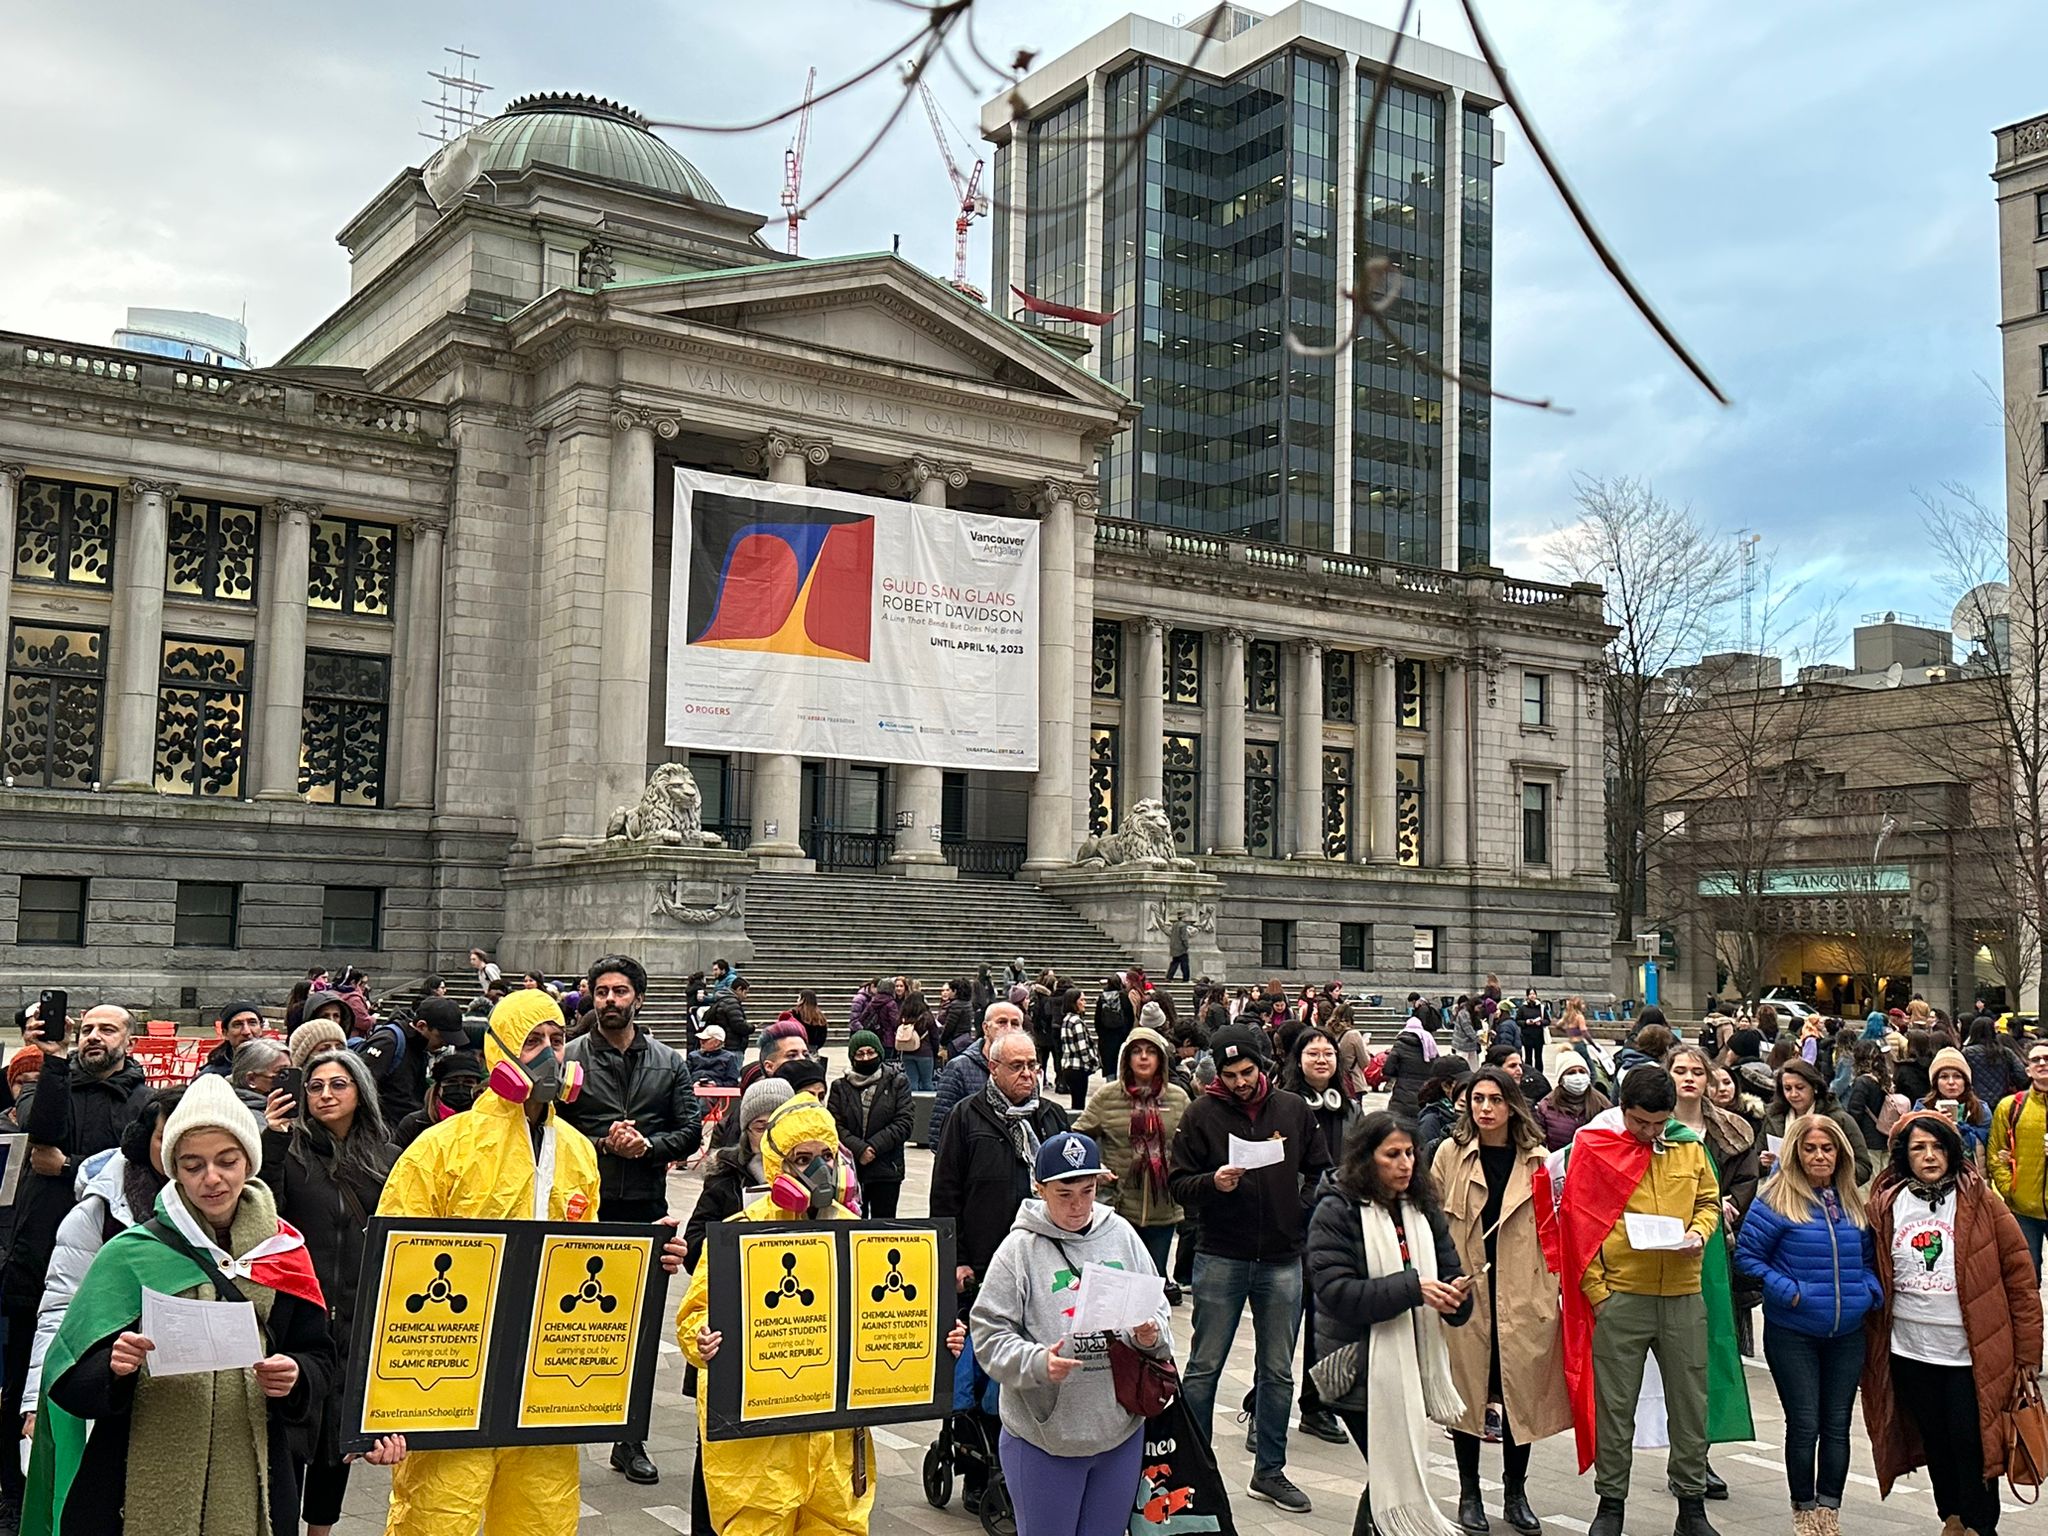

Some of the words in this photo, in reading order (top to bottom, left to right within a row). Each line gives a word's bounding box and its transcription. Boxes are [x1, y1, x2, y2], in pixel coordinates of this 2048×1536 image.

[684, 365, 849, 417] VANCOUVER
[862, 401, 911, 427] ART
[924, 412, 1031, 449] GALLERY
[970, 530, 1025, 546] Vancouver
[983, 543, 1024, 558] Artgallery
[931, 584, 960, 601] SAN
[965, 589, 1016, 607] GLANS
[882, 595, 942, 615] ROBERT
[945, 603, 1024, 623] DAVIDSON
[890, 614, 905, 623] Line
[908, 615, 925, 625] That
[950, 621, 962, 630] But
[964, 624, 982, 633] Does
[984, 626, 998, 634] Not
[1000, 627, 1023, 635] Break
[930, 637, 955, 649] UNTIL
[957, 641, 984, 652] APRIL
[986, 644, 999, 655] 16,
[1001, 645, 1024, 654] 2023
[695, 705, 730, 716] ROGERS
[1792, 873, 1878, 889] VANCOUVER
[1895, 1223, 1916, 1249] WOMAN
[410, 1238, 453, 1247] ATTENTION
[454, 1240, 483, 1248] PLEASE
[564, 1242, 605, 1250] ATTENTION
[606, 1243, 632, 1251] PLEASE
[759, 1240, 794, 1248] ATTENTION
[861, 1310, 896, 1319] CHEMICAL
[897, 1309, 928, 1318] WARFARE
[754, 1317, 792, 1327] CHEMICAL
[793, 1314, 827, 1324] WARFARE
[862, 1321, 892, 1330] AGAINST
[892, 1320, 928, 1329] STUDENTS
[389, 1323, 435, 1332] CHEMICAL
[437, 1323, 480, 1332] WARFARE
[544, 1323, 587, 1331] CHEMICAL
[588, 1322, 628, 1331] WARFARE
[755, 1328, 787, 1338] AGAINST
[789, 1325, 827, 1336] STUDENTS
[387, 1335, 428, 1344] AGAINST
[430, 1335, 478, 1343] STUDENTS
[543, 1334, 581, 1343] AGAINST
[582, 1334, 626, 1342] STUDENTS
[874, 1333, 897, 1341] carrying
[898, 1332, 907, 1340] out
[908, 1332, 916, 1340] by
[768, 1340, 793, 1349] carrying
[794, 1339, 806, 1347] out
[806, 1338, 815, 1347] by
[865, 1342, 891, 1352] ISLAMIC
[892, 1341, 923, 1350] REPUBLIC
[402, 1348, 433, 1357] carrying
[434, 1348, 448, 1356] out
[450, 1348, 460, 1357] by
[556, 1346, 586, 1355] carrying
[600, 1346, 610, 1354] by
[759, 1350, 788, 1360] ISLAMIC
[789, 1347, 823, 1358] REPUBLIC
[389, 1359, 425, 1368] ISLAMIC
[427, 1359, 469, 1368] REPUBLIC
[544, 1357, 578, 1366] ISLAMIC
[579, 1357, 618, 1365] REPUBLIC
[747, 1391, 831, 1407] #SaveIranianSchoolgirls
[370, 1407, 474, 1419] #SaveIranianSchoolgirls
[527, 1403, 622, 1414] #SaveIranianSchoolgirls
[1144, 1437, 1176, 1456] neo
